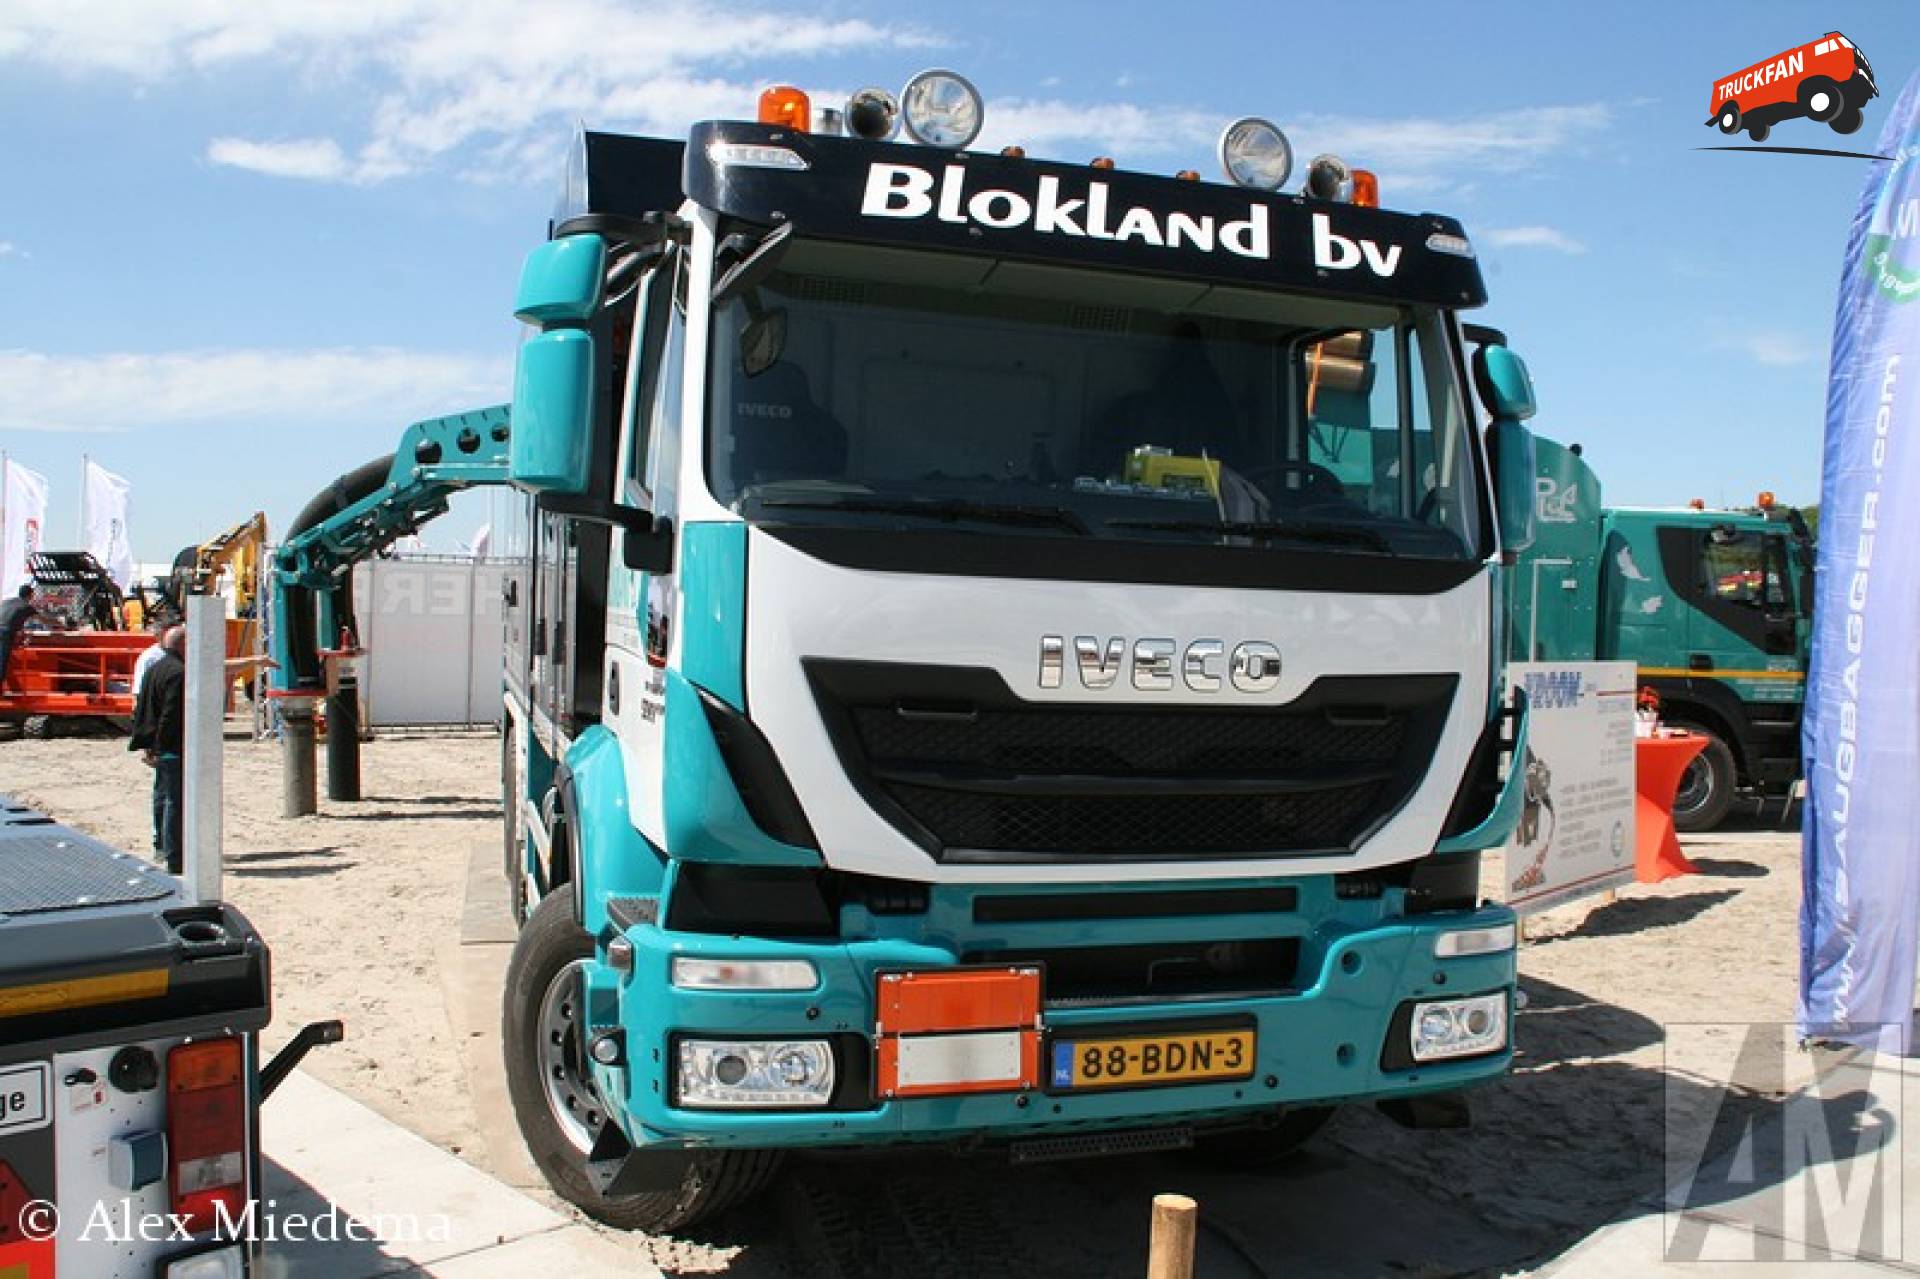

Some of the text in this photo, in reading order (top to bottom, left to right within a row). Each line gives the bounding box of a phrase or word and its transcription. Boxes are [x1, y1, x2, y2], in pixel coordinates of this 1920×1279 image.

[1312, 213, 1402, 278] bv
[736, 402, 793, 419] IVECO
[1038, 635, 1282, 693] IVECO
[1081, 1038, 1243, 1078] 88-BDN-3
